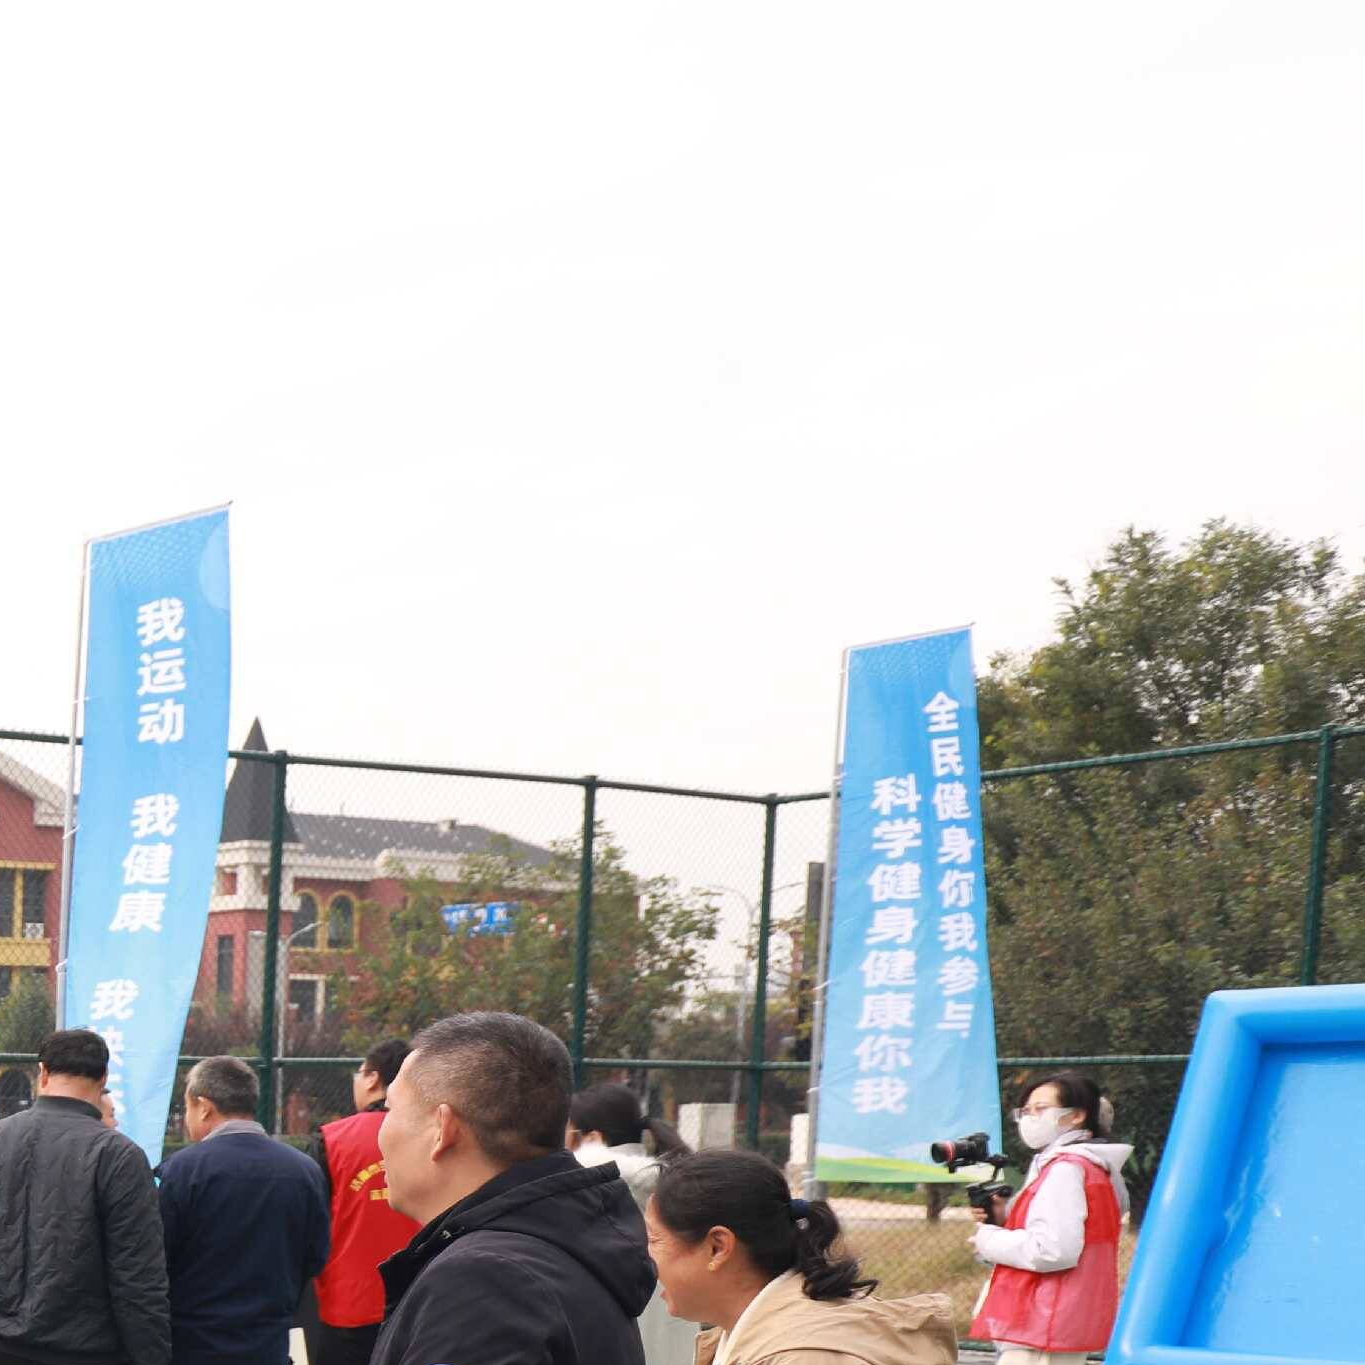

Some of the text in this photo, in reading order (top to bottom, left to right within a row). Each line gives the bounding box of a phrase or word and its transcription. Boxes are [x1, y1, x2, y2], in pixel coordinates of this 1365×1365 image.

[136, 596, 185, 746] 我运动
[109, 792, 180, 935] 我健康
[851, 772, 923, 1116] 科学健身健康你我
[923, 690, 978, 1039] 全民健身你我参与
